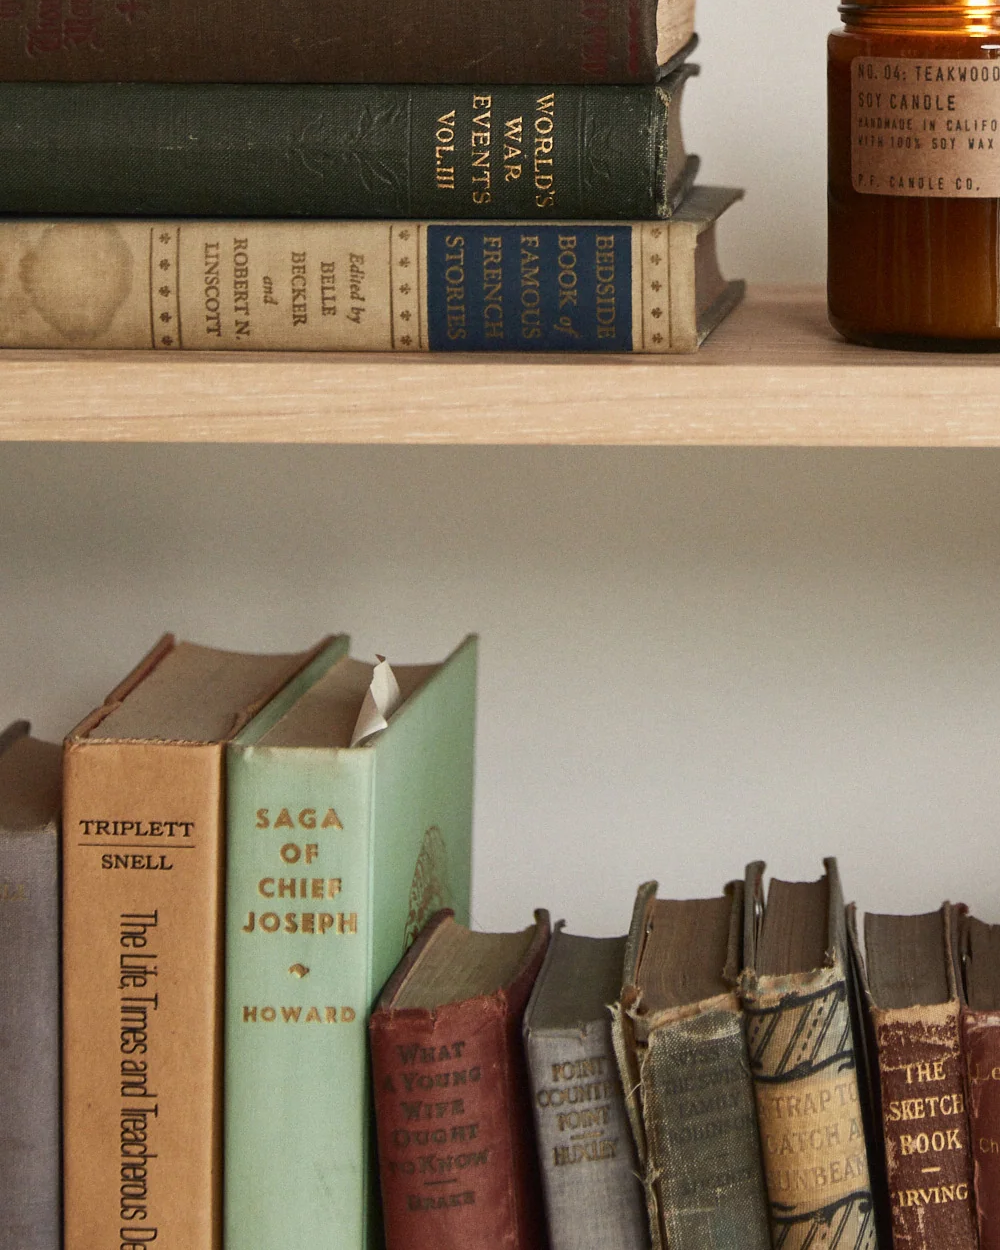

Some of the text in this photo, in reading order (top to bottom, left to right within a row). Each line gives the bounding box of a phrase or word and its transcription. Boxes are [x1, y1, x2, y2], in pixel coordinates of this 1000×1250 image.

[858, 64, 878, 80] NO.
[884, 65, 907, 81] 04:
[916, 66, 1000, 81] TEAKWOOD
[858, 93, 957, 111] SOY CANDLE
[859, 119, 913, 130] HANDMADE
[924, 119, 936, 130] IN
[471, 94, 492, 205] EVENTS
[503, 116, 523, 182] WAR
[534, 92, 556, 208] WORLD'S
[858, 136, 995, 150] WITH 100% SOY WAX
[889, 177, 945, 190] CANDLE
[204, 242, 222, 337] LINSCOTT
[233, 237, 250, 316] ROBERT
[262, 275, 279, 306] and
[291, 251, 308, 327] BECKER
[320, 261, 337, 316] BELLE
[346, 252, 366, 325] Edited by
[445, 235, 467, 341] STORIES
[483, 236, 504, 339] FRENCH
[520, 234, 541, 339] FAMOUS
[553, 234, 581, 339] BOOK of
[595, 234, 616, 339] BEDSIDE
[79, 820, 195, 838] TRIPLETT
[255, 808, 344, 831] SAGA
[101, 854, 173, 871] SNELL
[279, 843, 319, 865] OF
[258, 877, 343, 899] CHIEF
[119, 909, 158, 949] The
[241, 911, 358, 935] JOSEPH
[119, 993, 158, 1055] Times
[242, 1006, 357, 1024] HOWARD
[119, 1059, 158, 1098] and
[400, 1067, 482, 1092] YOUNG
[905, 1062, 946, 1084] THE
[401, 1099, 465, 1120] WIFE
[889, 1093, 965, 1121] SKETCH
[900, 1129, 962, 1155] BOOK
[119, 1103, 158, 1221] Treacherous
[899, 1183, 968, 1207] IRVING
